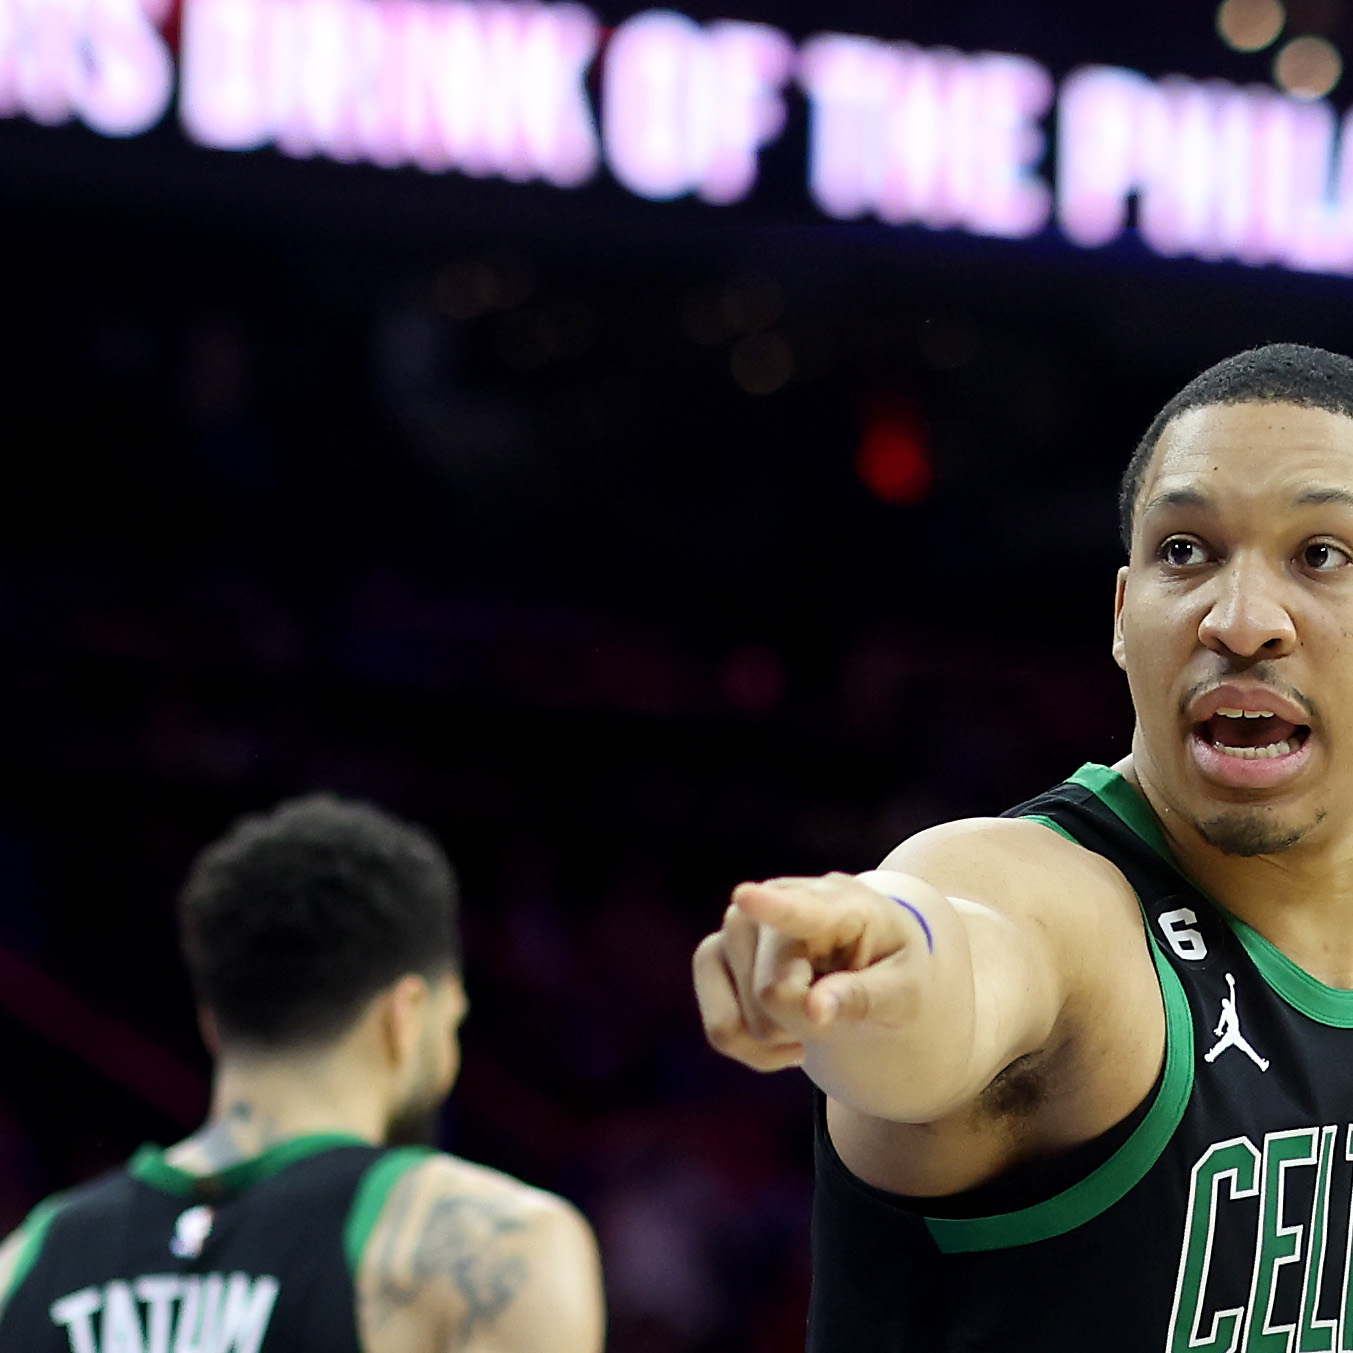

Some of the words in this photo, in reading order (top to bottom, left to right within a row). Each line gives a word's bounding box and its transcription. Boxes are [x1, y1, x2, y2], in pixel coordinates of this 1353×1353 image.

[602, 12, 797, 203] OF
[799, 32, 1053, 240] THE
[1157, 907, 1208, 961] 6
